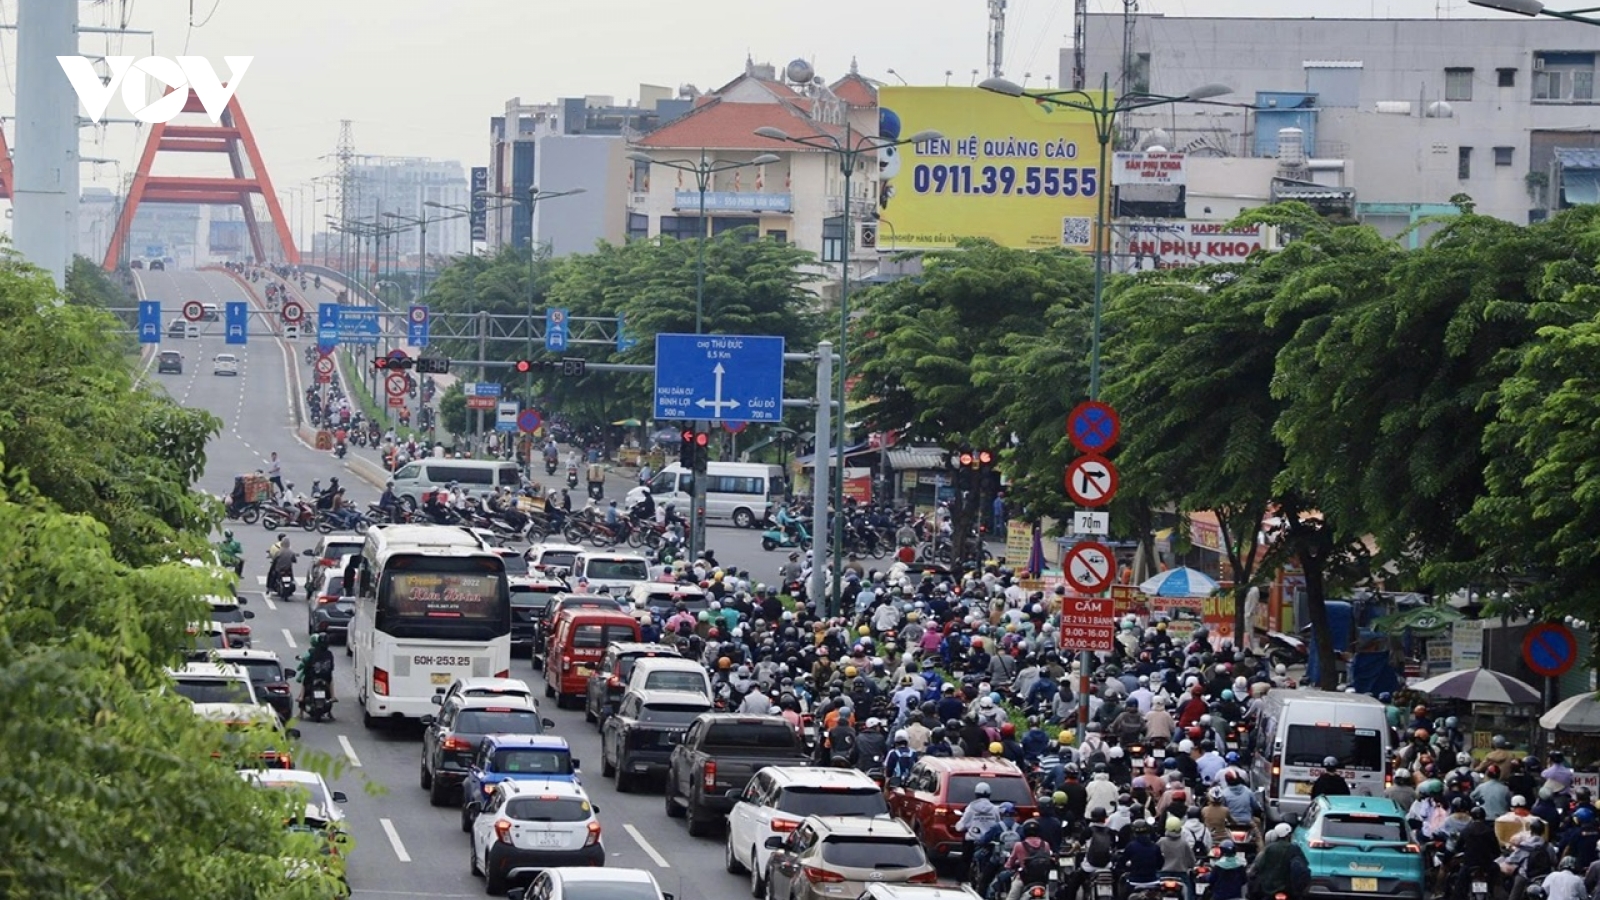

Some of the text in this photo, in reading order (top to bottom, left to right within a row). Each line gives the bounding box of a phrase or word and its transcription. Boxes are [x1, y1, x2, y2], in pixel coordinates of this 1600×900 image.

[957, 136, 977, 159] HỆ
[984, 137, 1038, 157] QUẢNG
[1045, 138, 1076, 158] CÁO
[1160, 161, 1181, 170] KHOA
[914, 164, 1097, 197] 0911.39.5555
[1160, 241, 1201, 260] PHỤ
[711, 337, 727, 348] THỦ
[727, 338, 743, 349] ĐỨC
[462, 579, 480, 587] 2022
[1075, 599, 1102, 612] CẤM
[1065, 628, 1109, 638] 9.00-16.00
[1064, 639, 1109, 649] 20.00-6.00
